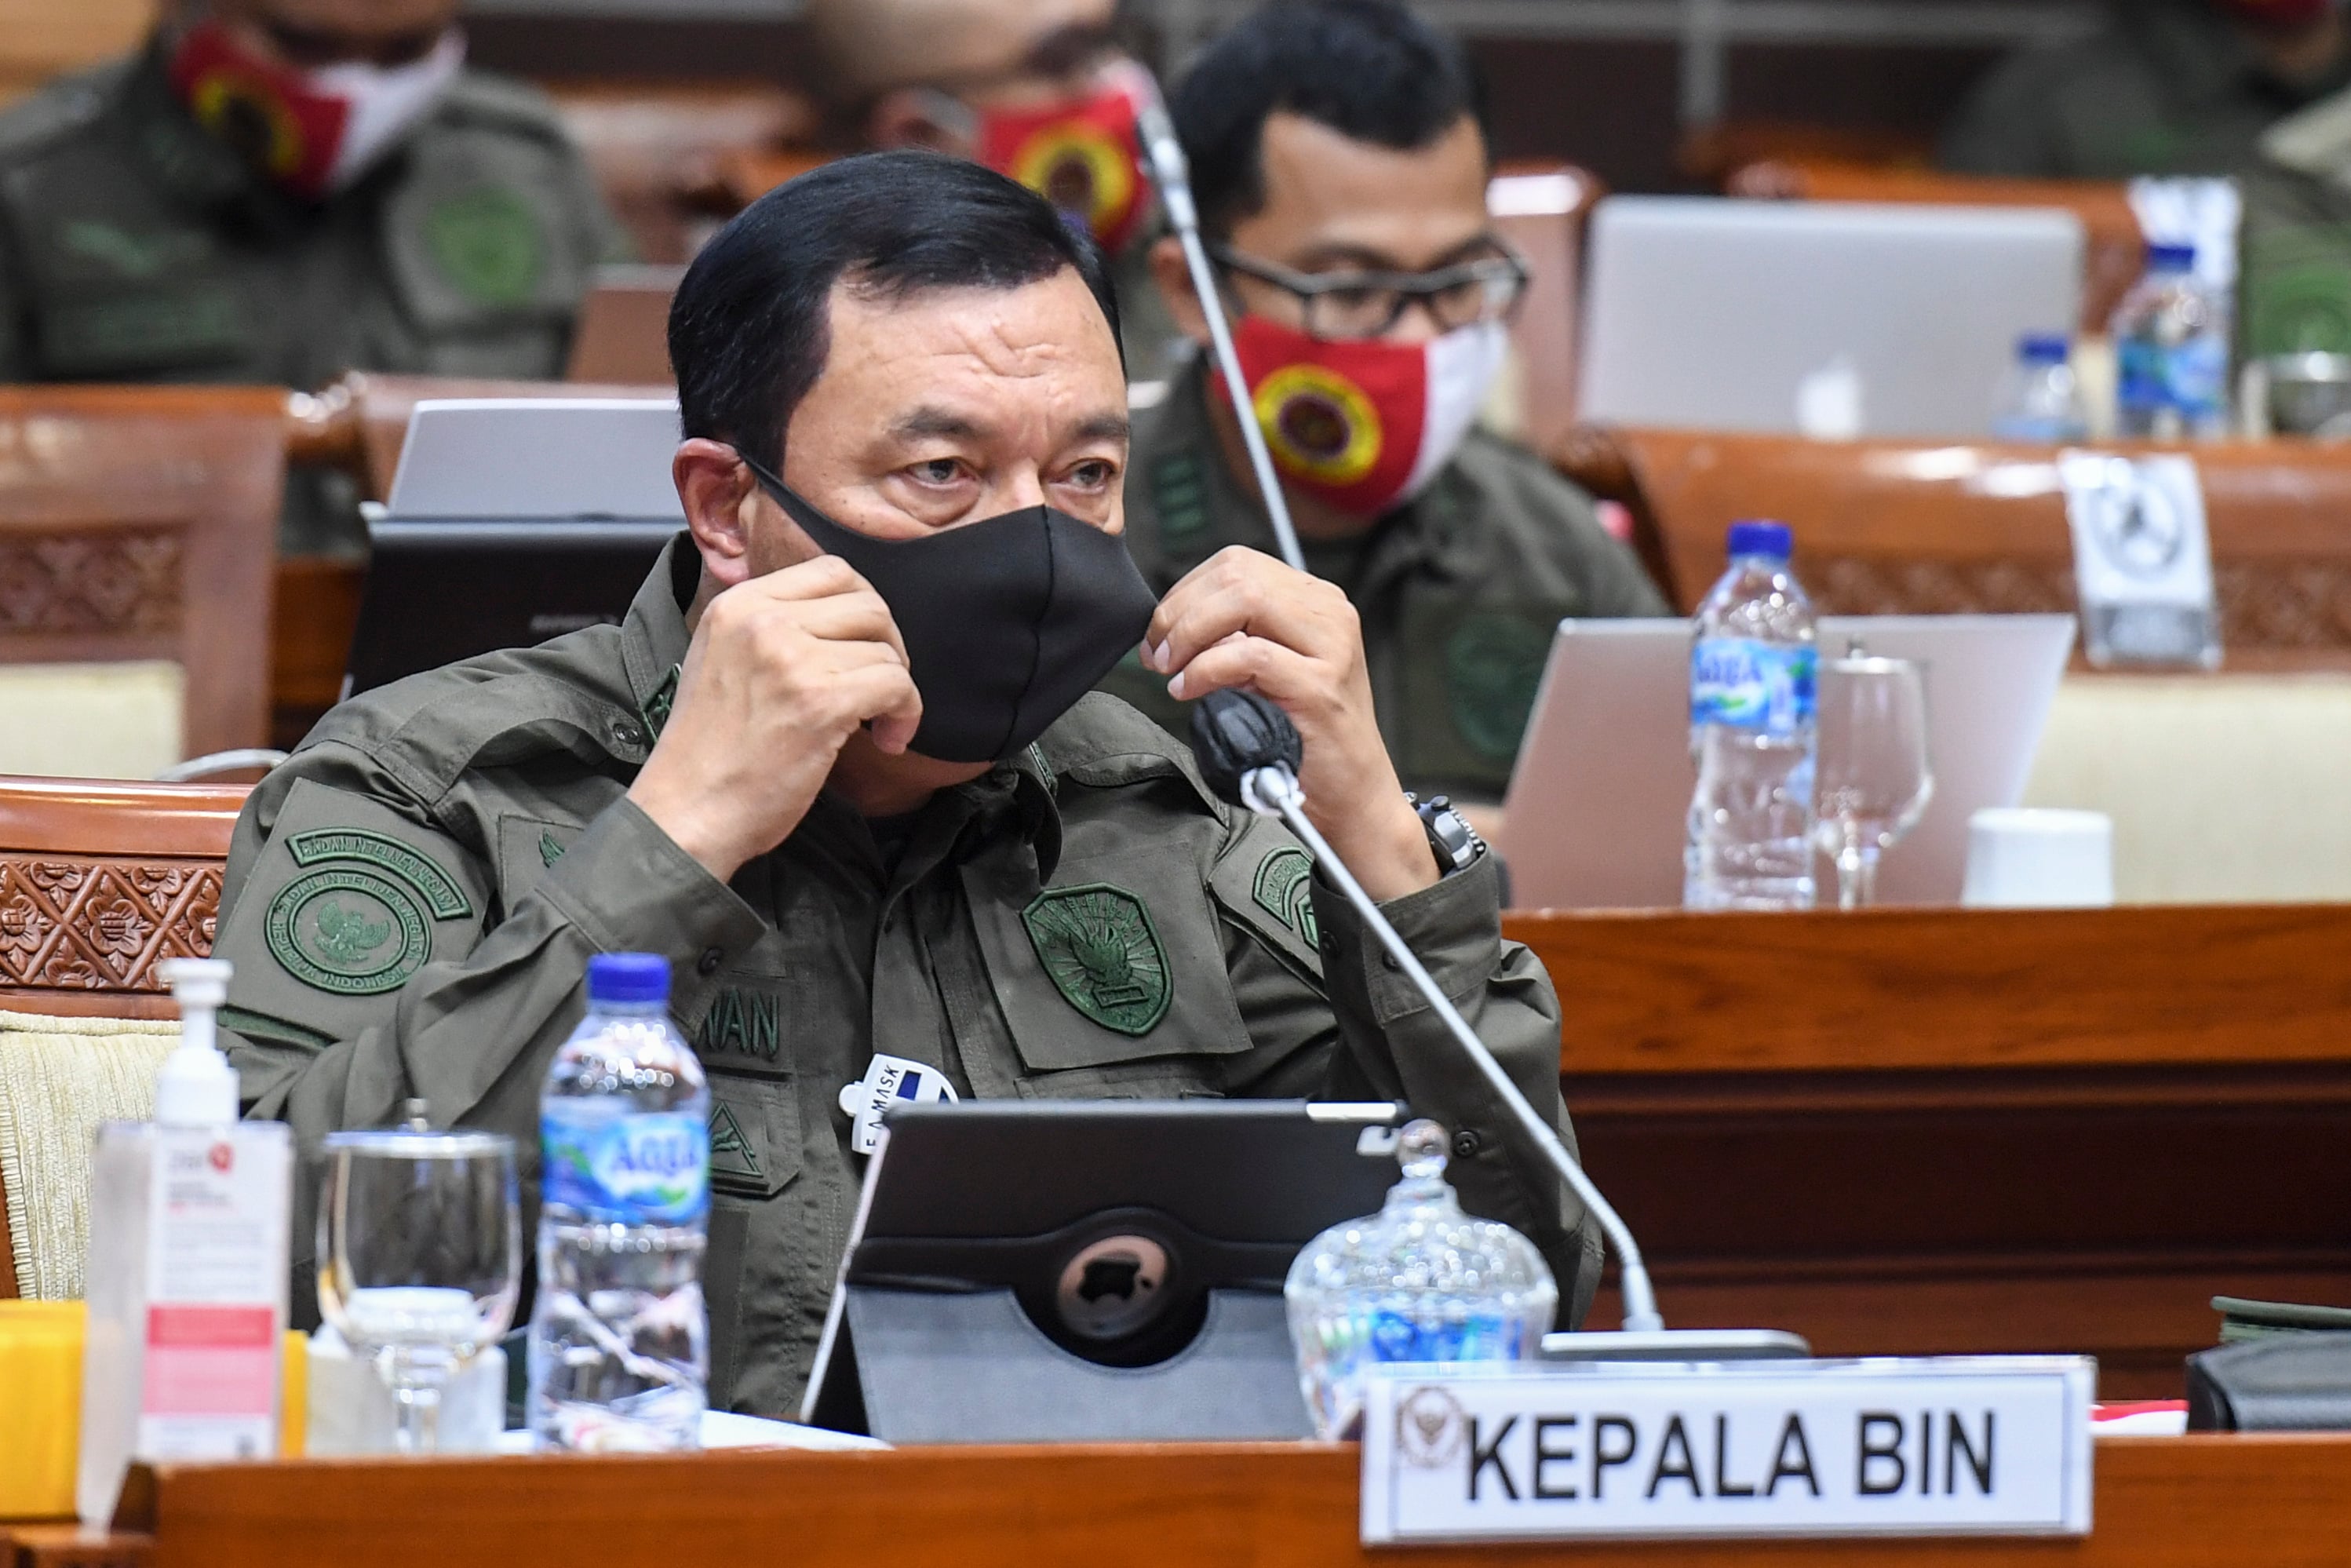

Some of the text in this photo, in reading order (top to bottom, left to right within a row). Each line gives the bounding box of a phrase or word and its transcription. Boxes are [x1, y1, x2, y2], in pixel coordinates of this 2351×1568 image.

[871, 1064, 899, 1114] MASK
[1466, 1410, 1997, 1501] KEPALA BIN
